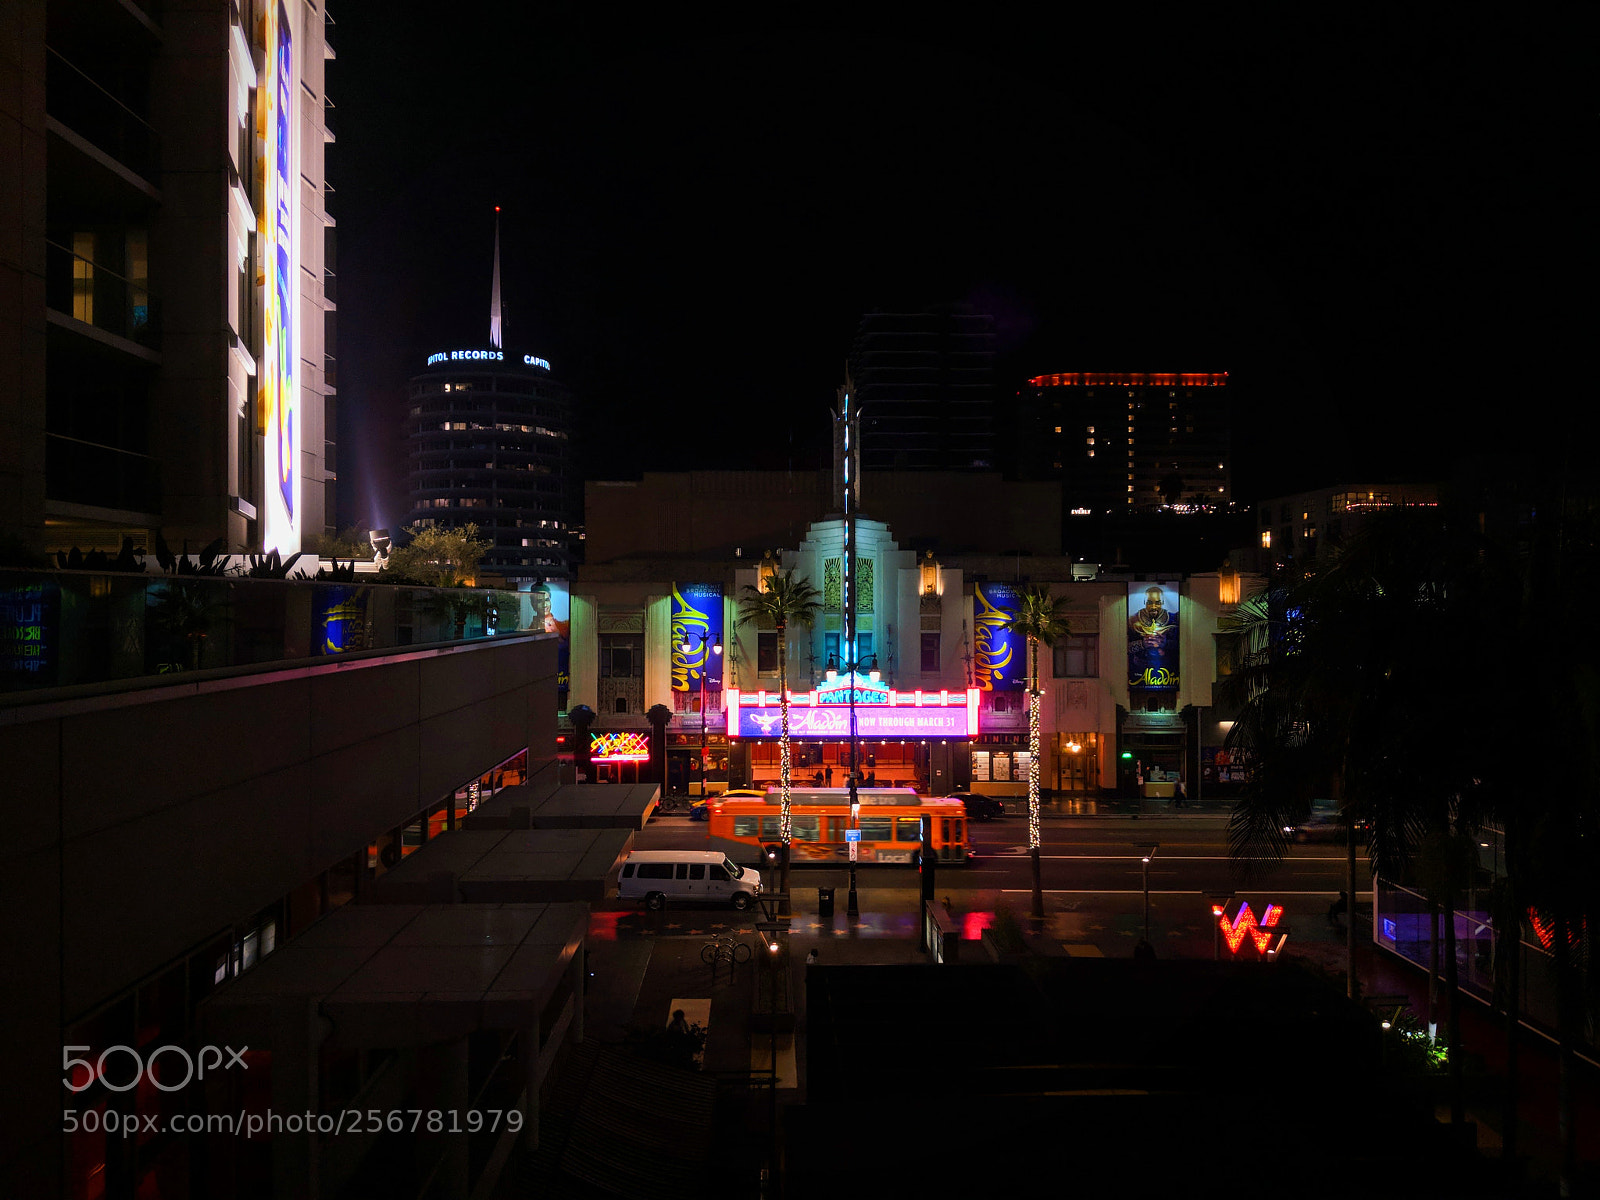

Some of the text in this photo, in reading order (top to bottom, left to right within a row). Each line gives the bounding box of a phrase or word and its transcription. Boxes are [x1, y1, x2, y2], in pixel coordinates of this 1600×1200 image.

[451, 350, 504, 360] RECORDS
[1128, 667, 1180, 686] Aladdin
[819, 689, 888, 703] PANTAGES
[789, 709, 848, 730] Aladdin
[858, 717, 955, 726] NOW THROUGH MARCH 31
